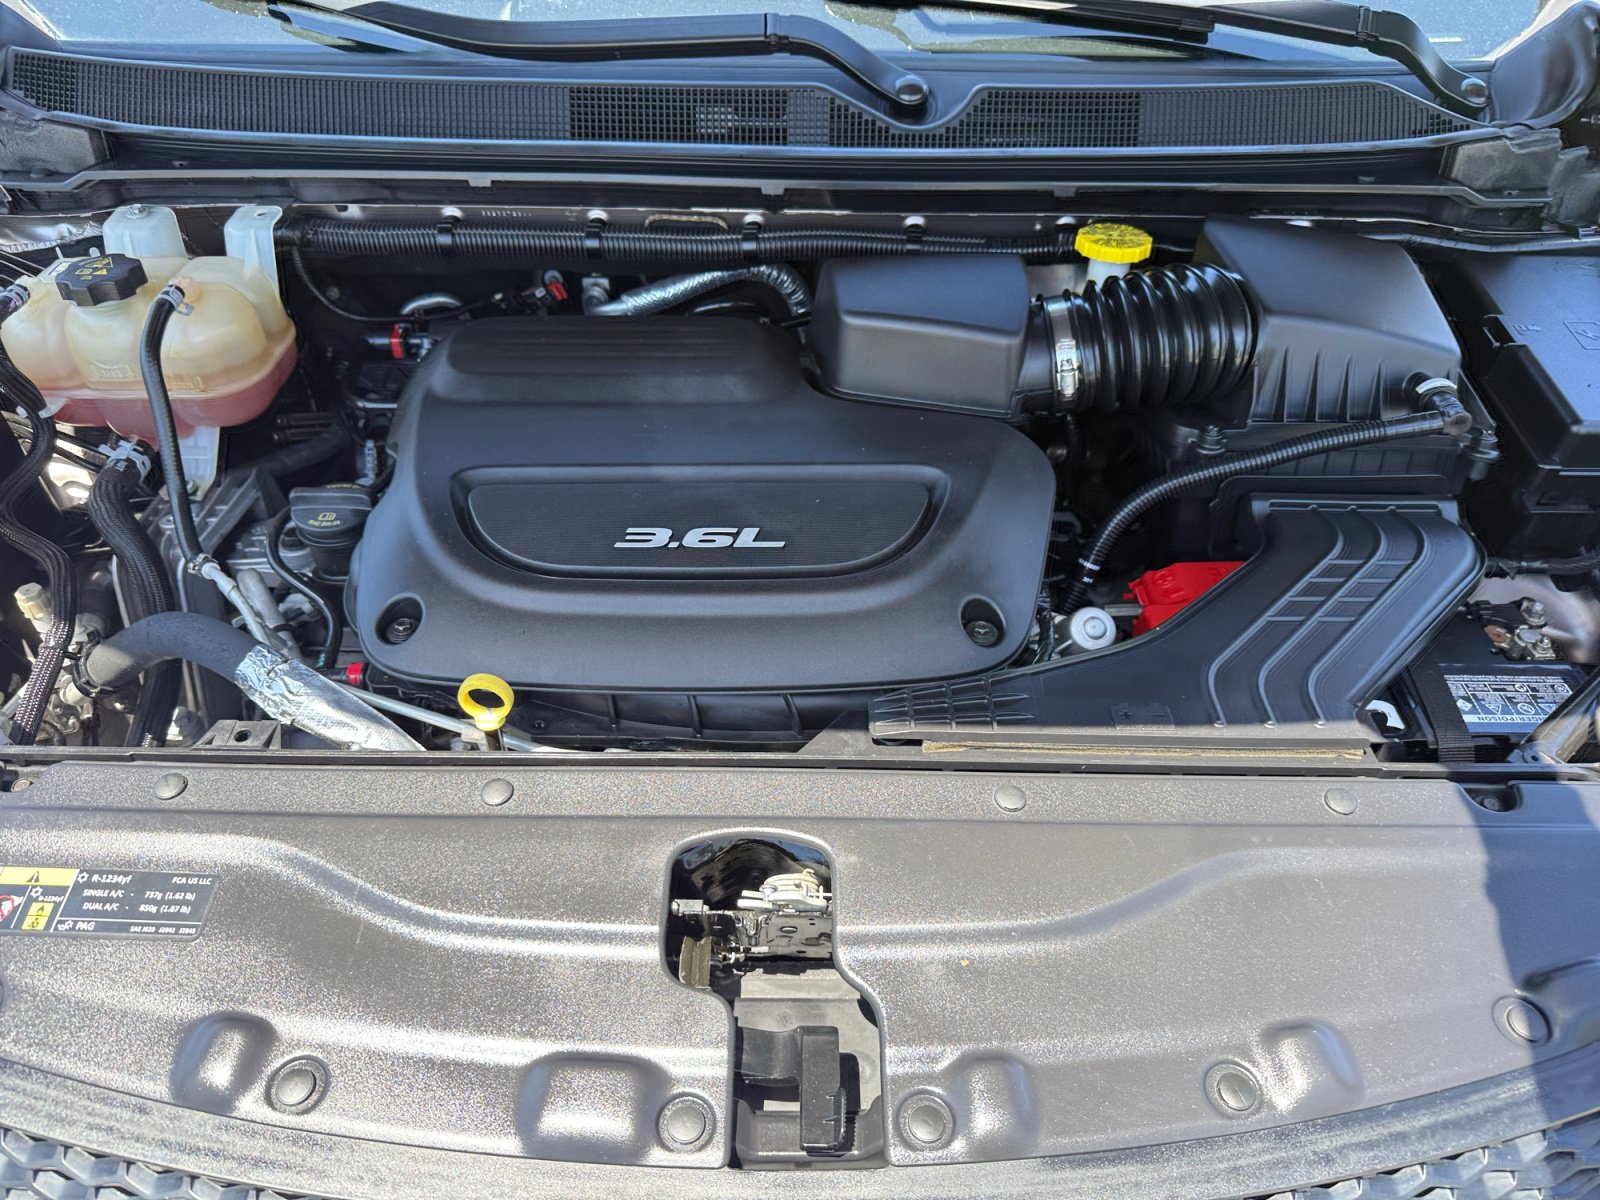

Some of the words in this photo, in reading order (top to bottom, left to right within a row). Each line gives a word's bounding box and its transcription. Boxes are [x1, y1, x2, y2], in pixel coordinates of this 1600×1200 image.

[613, 527, 786, 548] 3.6L
[91, 873, 133, 885] R-1234yf
[172, 876, 186, 884] FCA
[198, 877, 213, 885] LLC
[82, 889, 109, 897] SINGLE
[108, 889, 124, 898] A/C
[185, 892, 196, 901] lb)
[82, 902, 104, 910] DUAL
[104, 902, 120, 911] A/C
[75, 921, 96, 931] PAG
